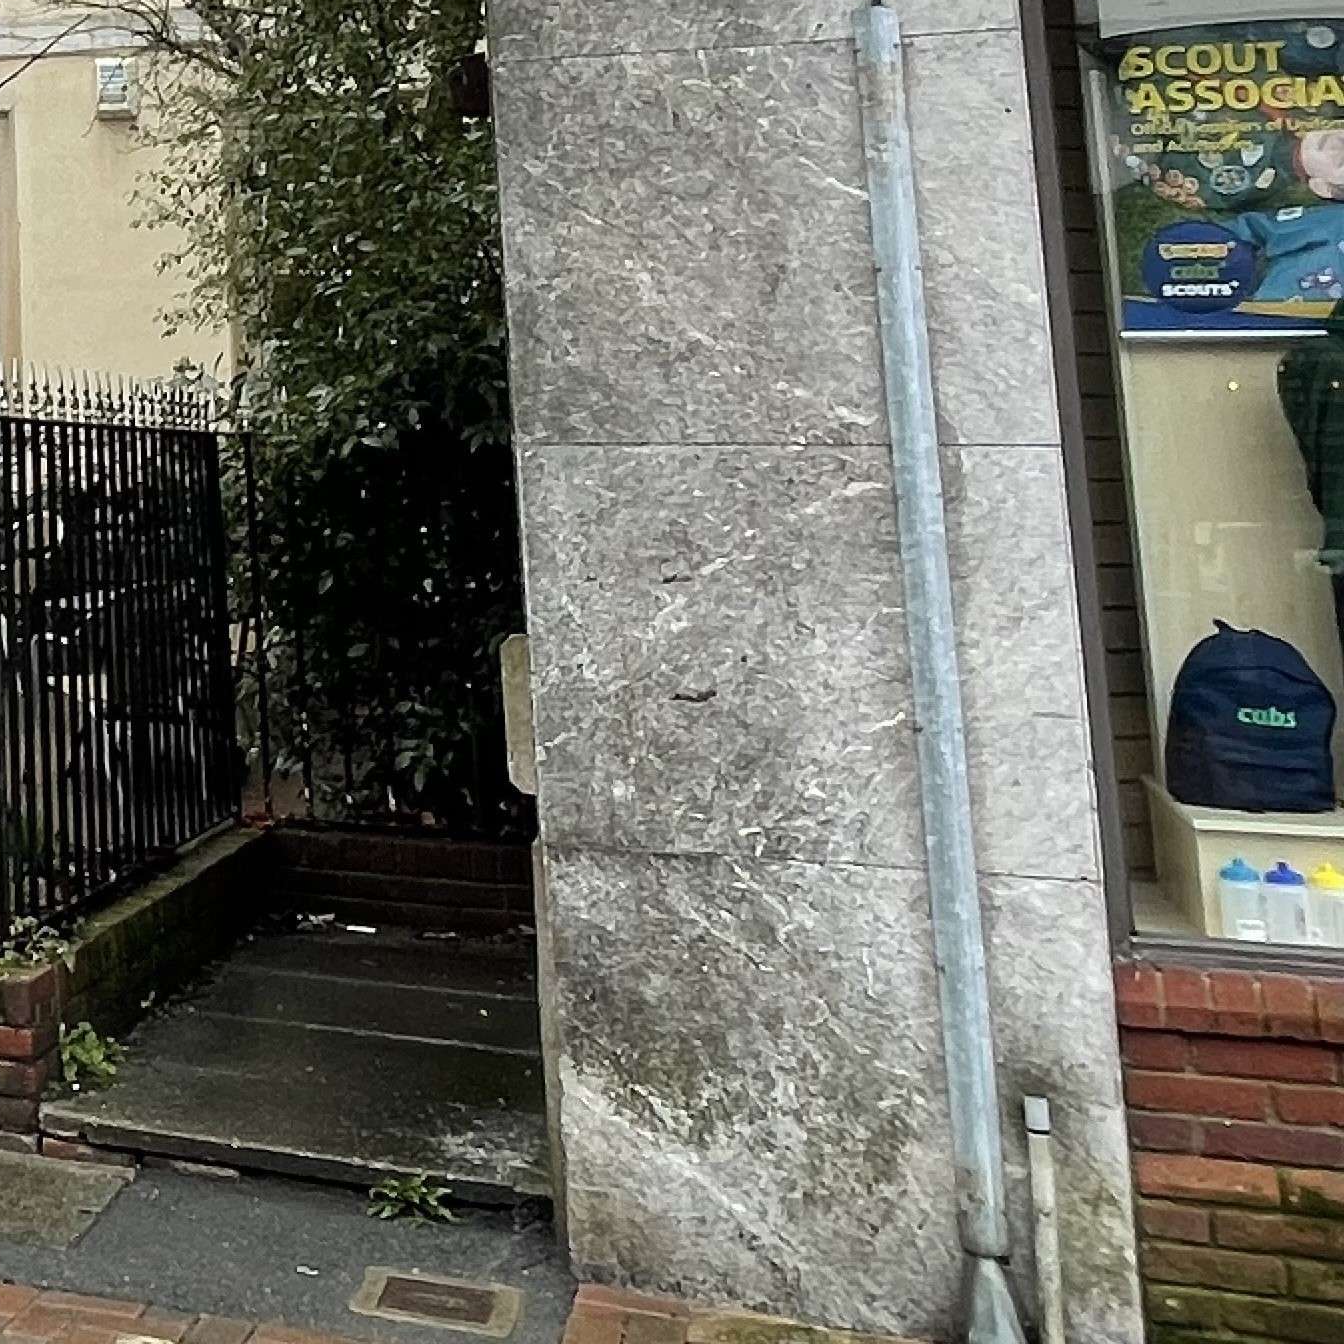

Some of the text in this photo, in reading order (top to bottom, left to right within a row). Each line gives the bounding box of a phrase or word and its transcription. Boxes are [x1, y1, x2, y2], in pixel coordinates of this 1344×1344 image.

[1119, 40, 1286, 80] SCOUT
[1129, 75, 1344, 114] ASSOCIA
[1237, 706, 1297, 728] cubs
